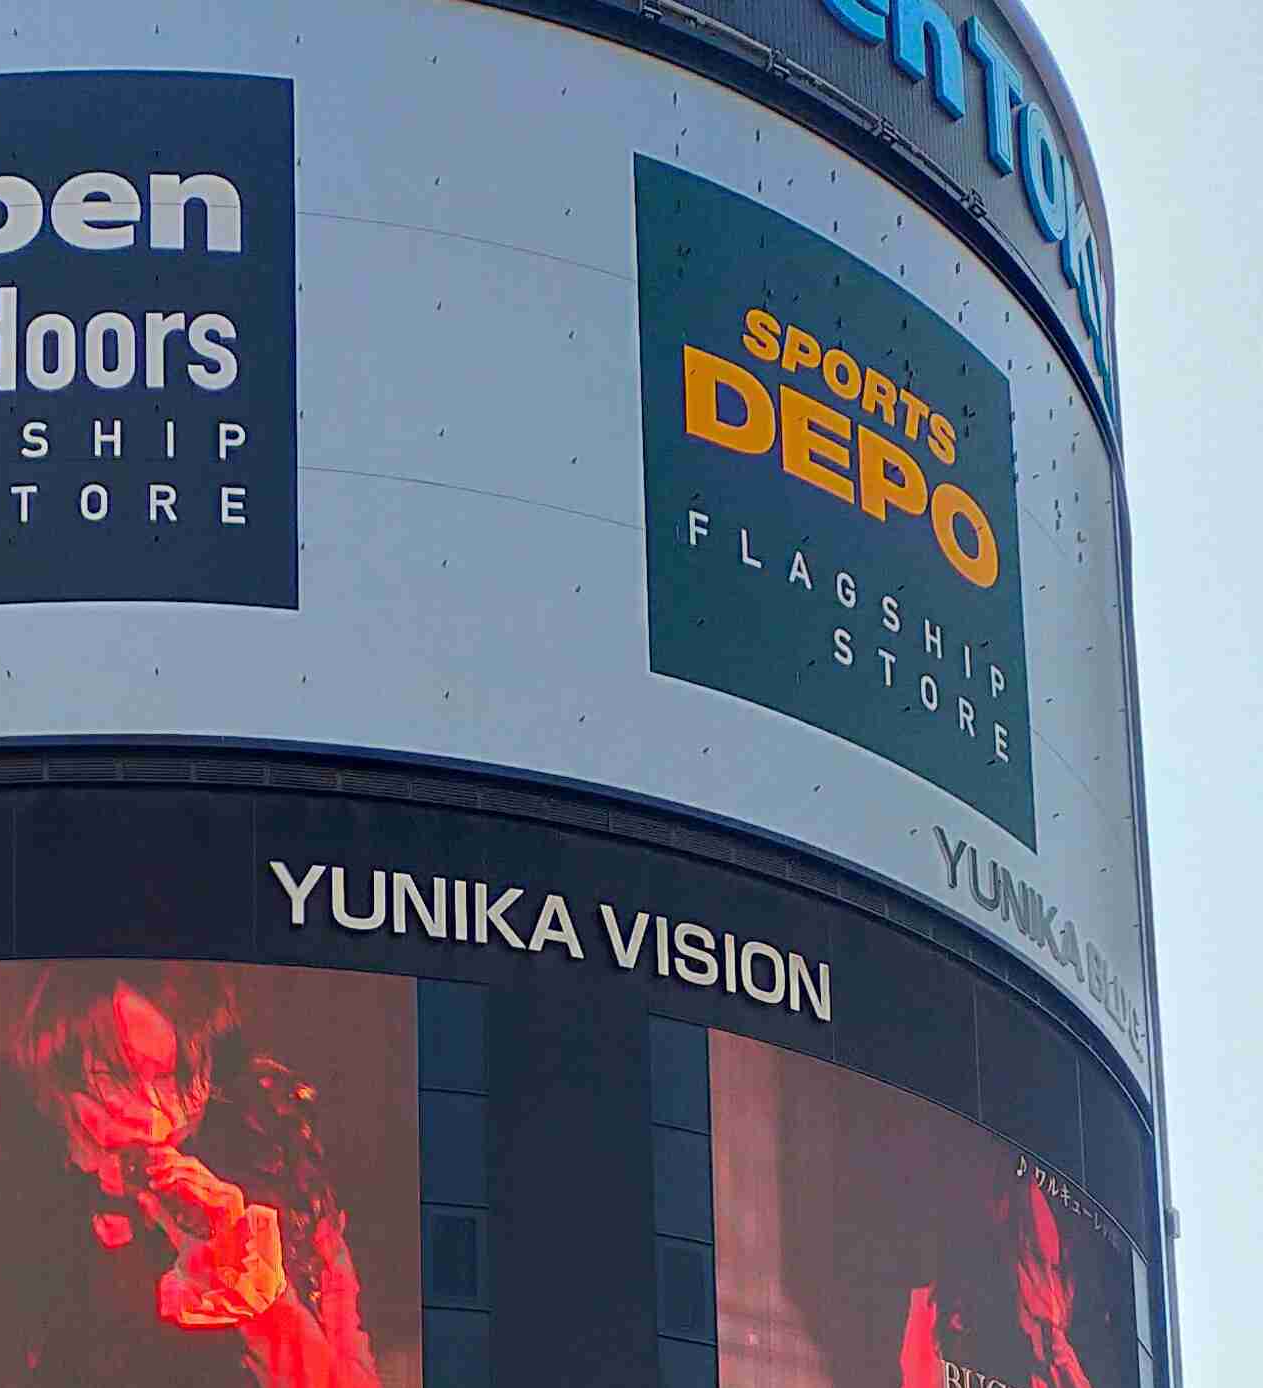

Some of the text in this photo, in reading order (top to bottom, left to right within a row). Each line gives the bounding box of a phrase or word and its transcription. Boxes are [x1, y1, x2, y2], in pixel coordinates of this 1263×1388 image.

[743, 306, 957, 466] SPORTS
[683, 345, 999, 589] DEPO
[689, 511, 1008, 699] FLAGSHIP
[833, 628, 1011, 764] STORE
[269, 861, 832, 1022] YUNIKA VISION
[932, 825, 1085, 982] YUNIKA
